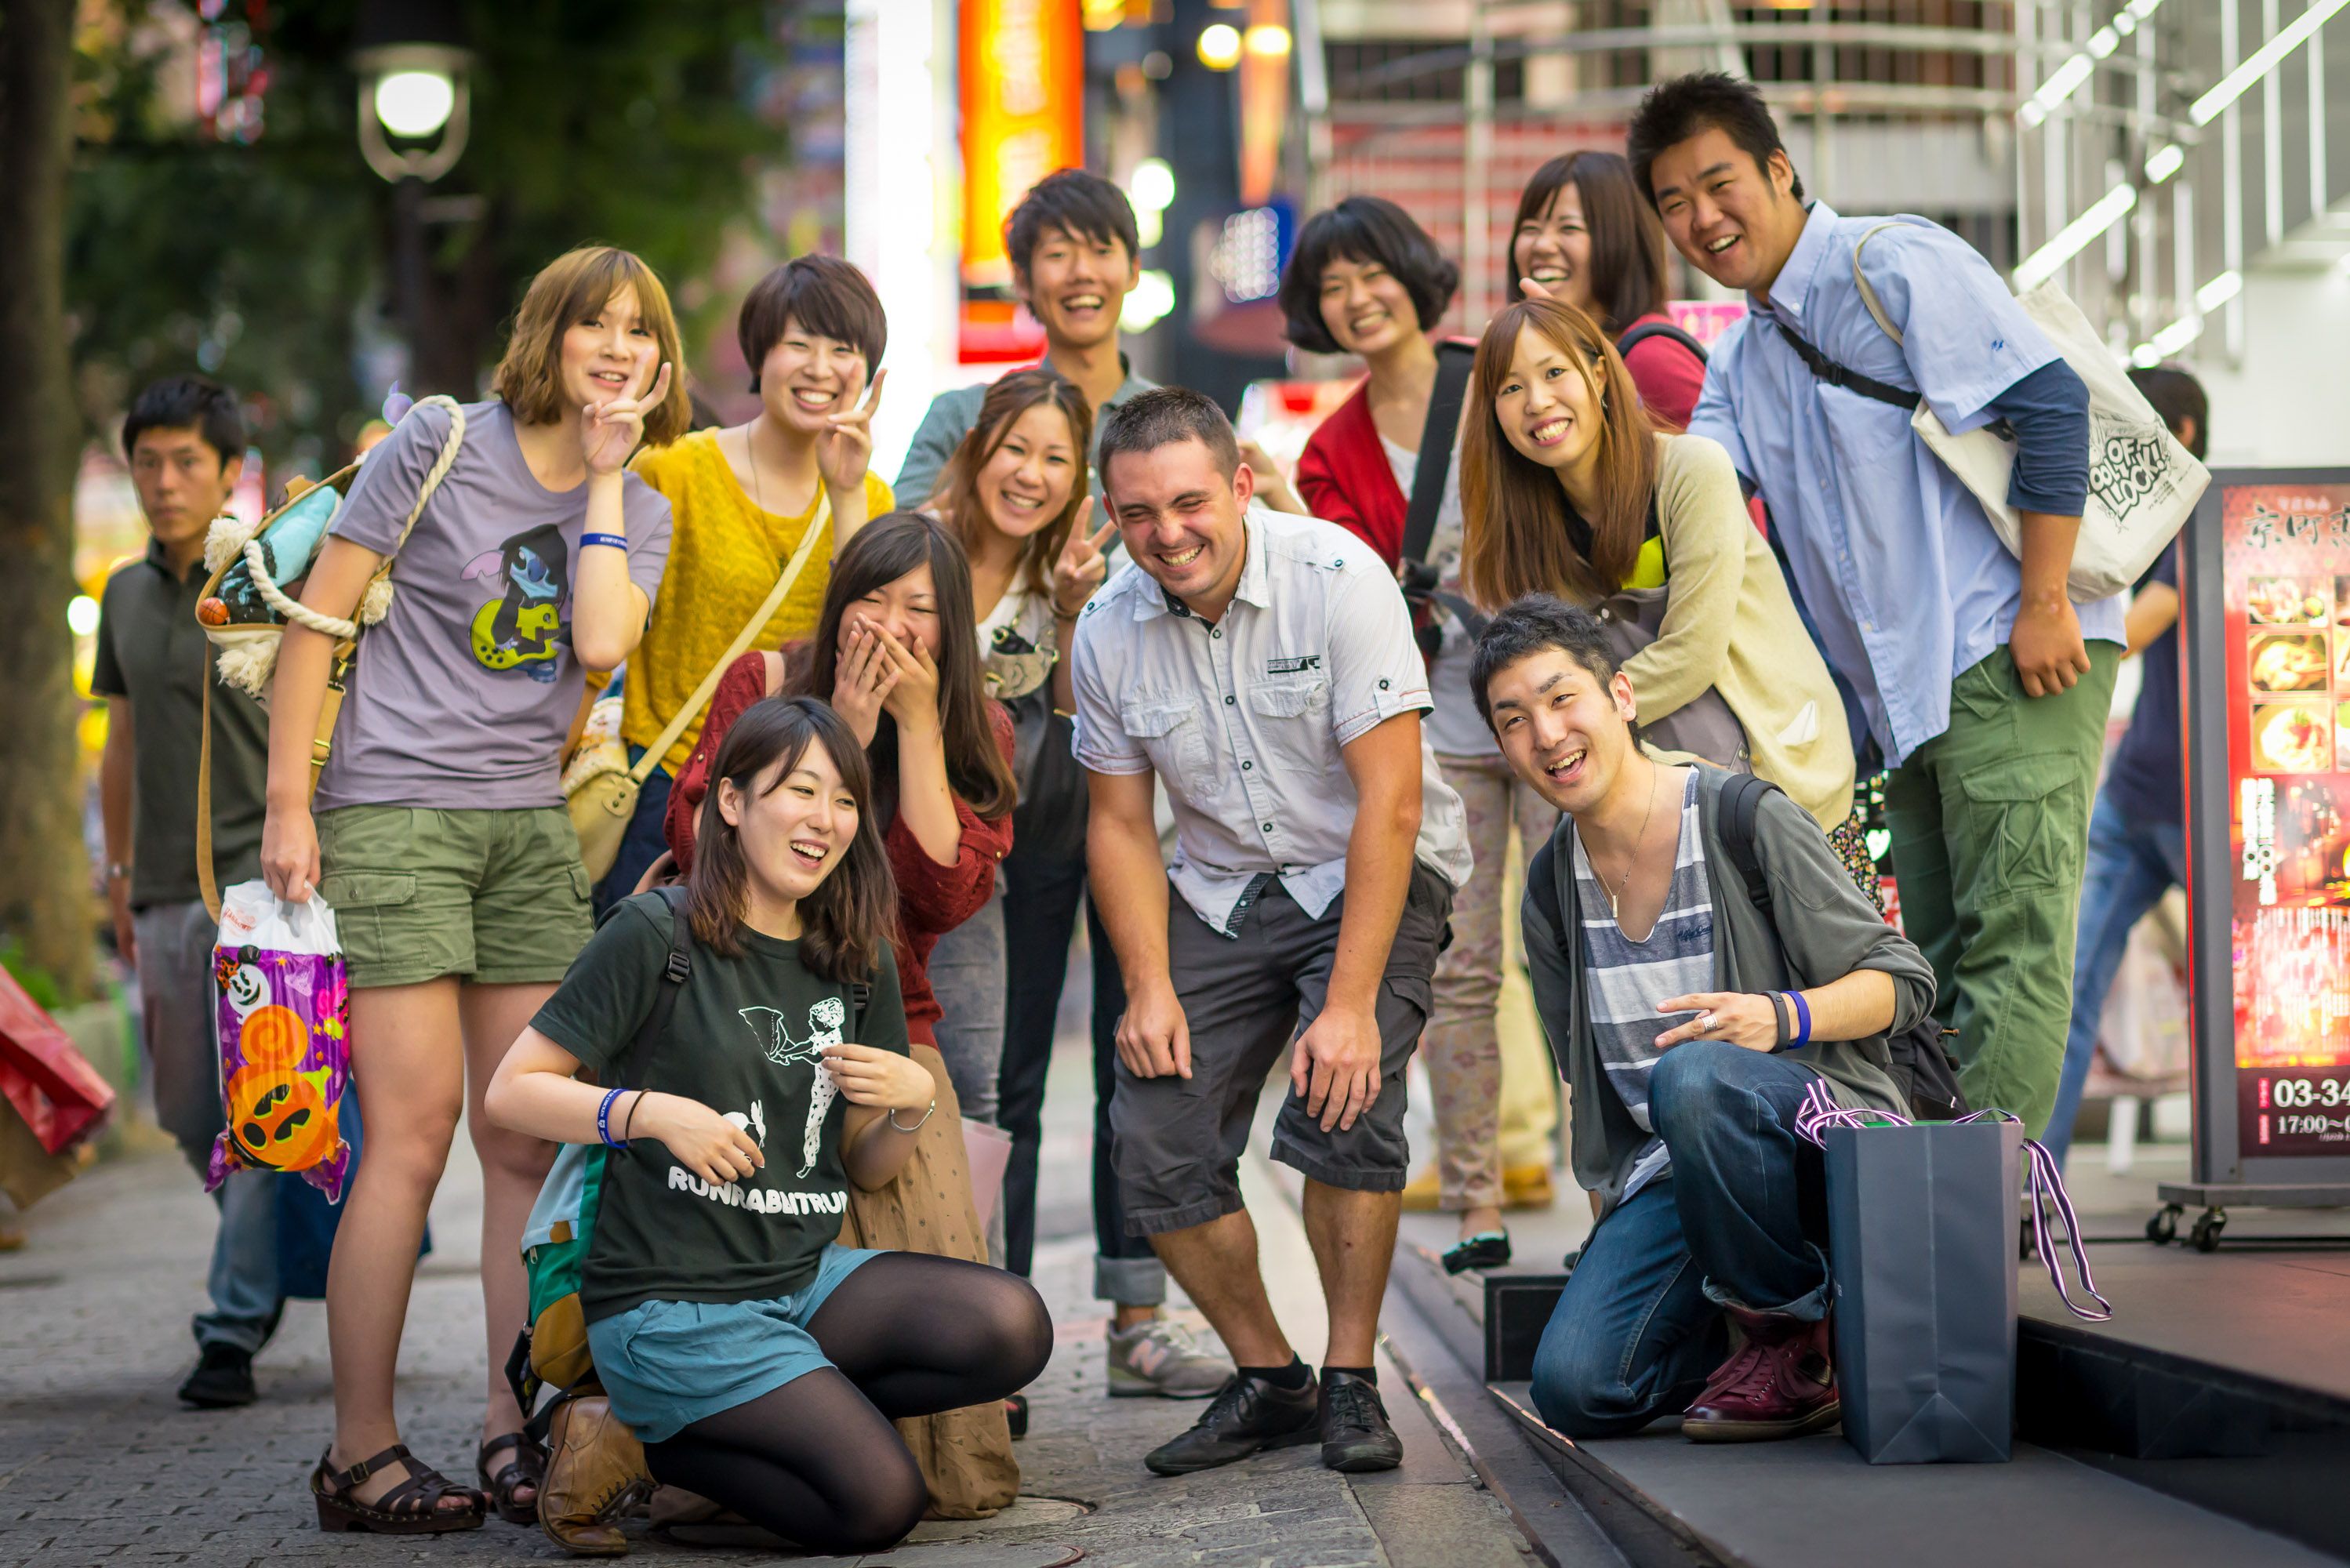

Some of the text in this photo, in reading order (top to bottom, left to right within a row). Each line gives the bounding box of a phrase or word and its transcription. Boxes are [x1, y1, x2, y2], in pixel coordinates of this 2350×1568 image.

[2106, 437, 2139, 468] OF
[2098, 440, 2166, 521] LOCK!
[1128, 1338, 1168, 1377] N
